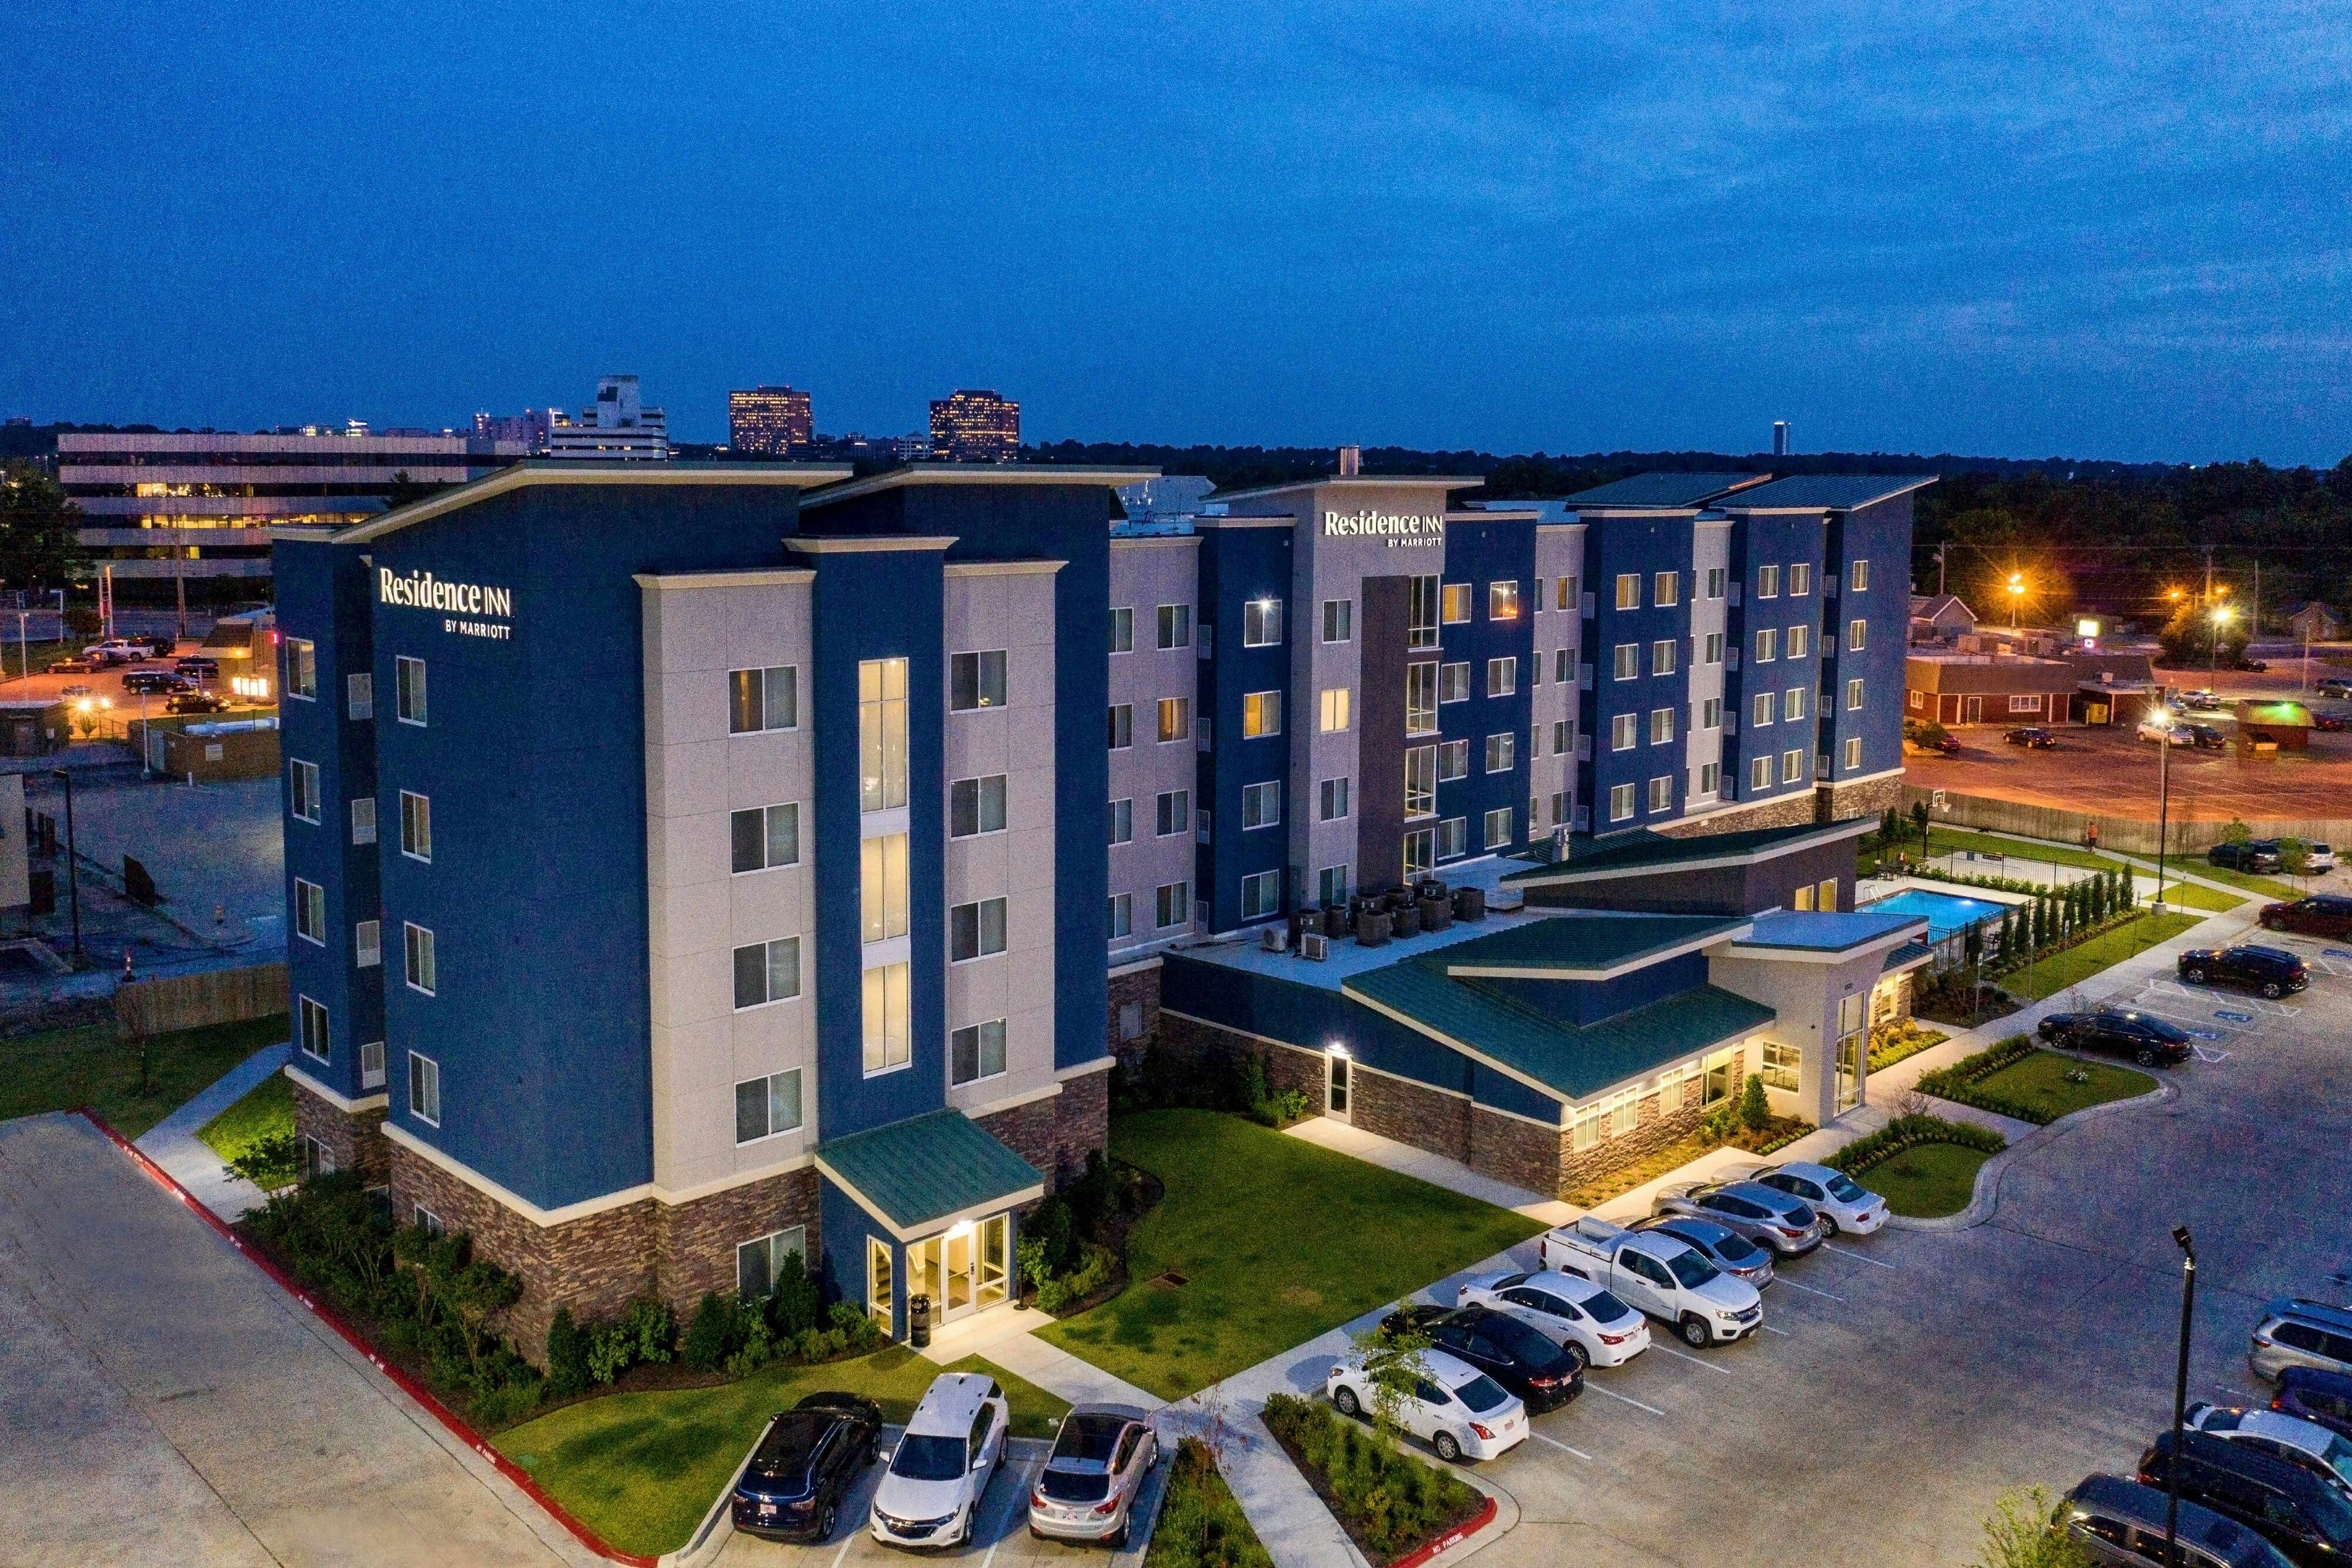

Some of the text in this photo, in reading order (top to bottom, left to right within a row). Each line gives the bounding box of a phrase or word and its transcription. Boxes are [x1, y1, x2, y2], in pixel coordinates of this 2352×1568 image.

[1325, 510, 1442, 536] Residence INN
[1388, 537, 1442, 547] BY MARRIOTT
[380, 568, 510, 617] Residence INN
[446, 619, 510, 640] BY MARRIOTT
[1432, 1532, 1464, 1554] NO PARKING
